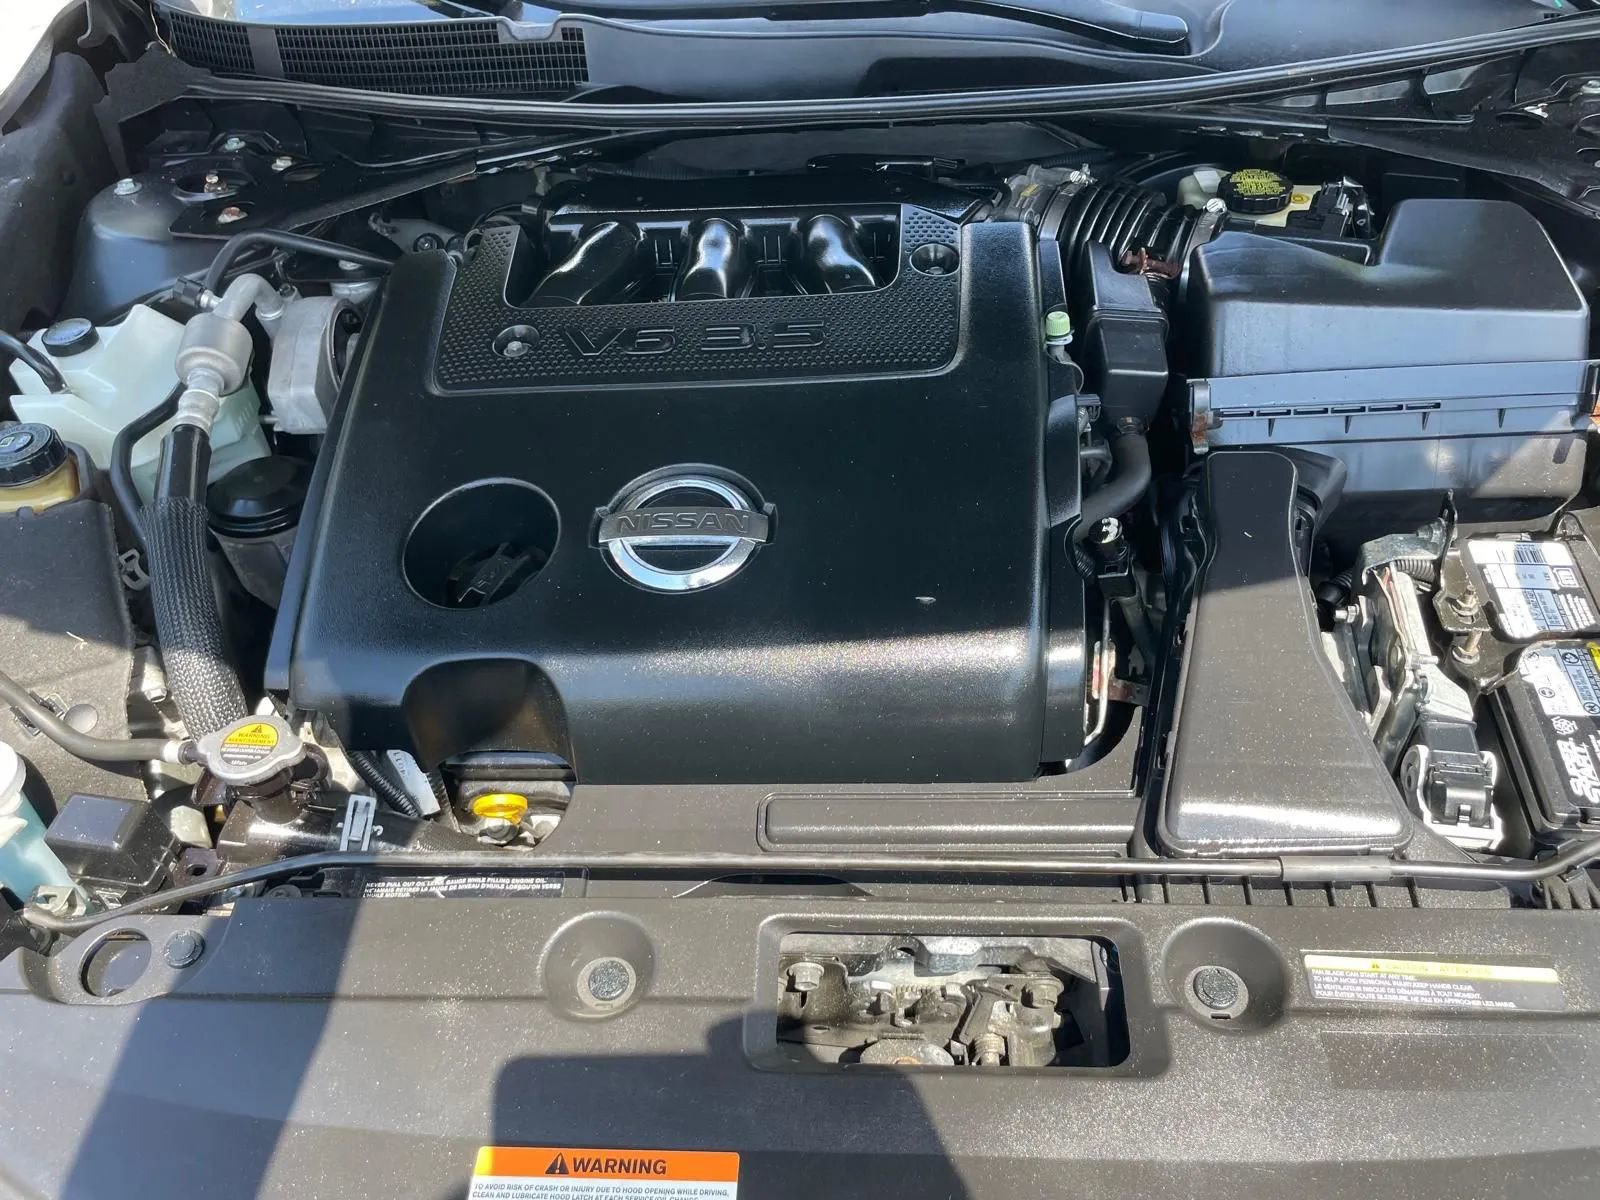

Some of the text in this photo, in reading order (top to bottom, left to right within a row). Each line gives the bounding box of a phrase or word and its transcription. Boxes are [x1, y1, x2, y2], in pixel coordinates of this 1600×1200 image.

[564, 319, 826, 356] V6 3.5
[616, 511, 749, 534] NISSAN
[238, 732, 271, 740] WARNING
[572, 1156, 667, 1175] WARNING
[472, 1191, 495, 1199] CLEAN
[511, 1192, 549, 1200] LUBRICATE
[507, 1183, 522, 1191] RISK
[535, 1184, 558, 1192] CRASH
[571, 1185, 595, 1193] INJURY
[644, 1187, 676, 1195] OPENING
[677, 1187, 698, 1195] WHILE
